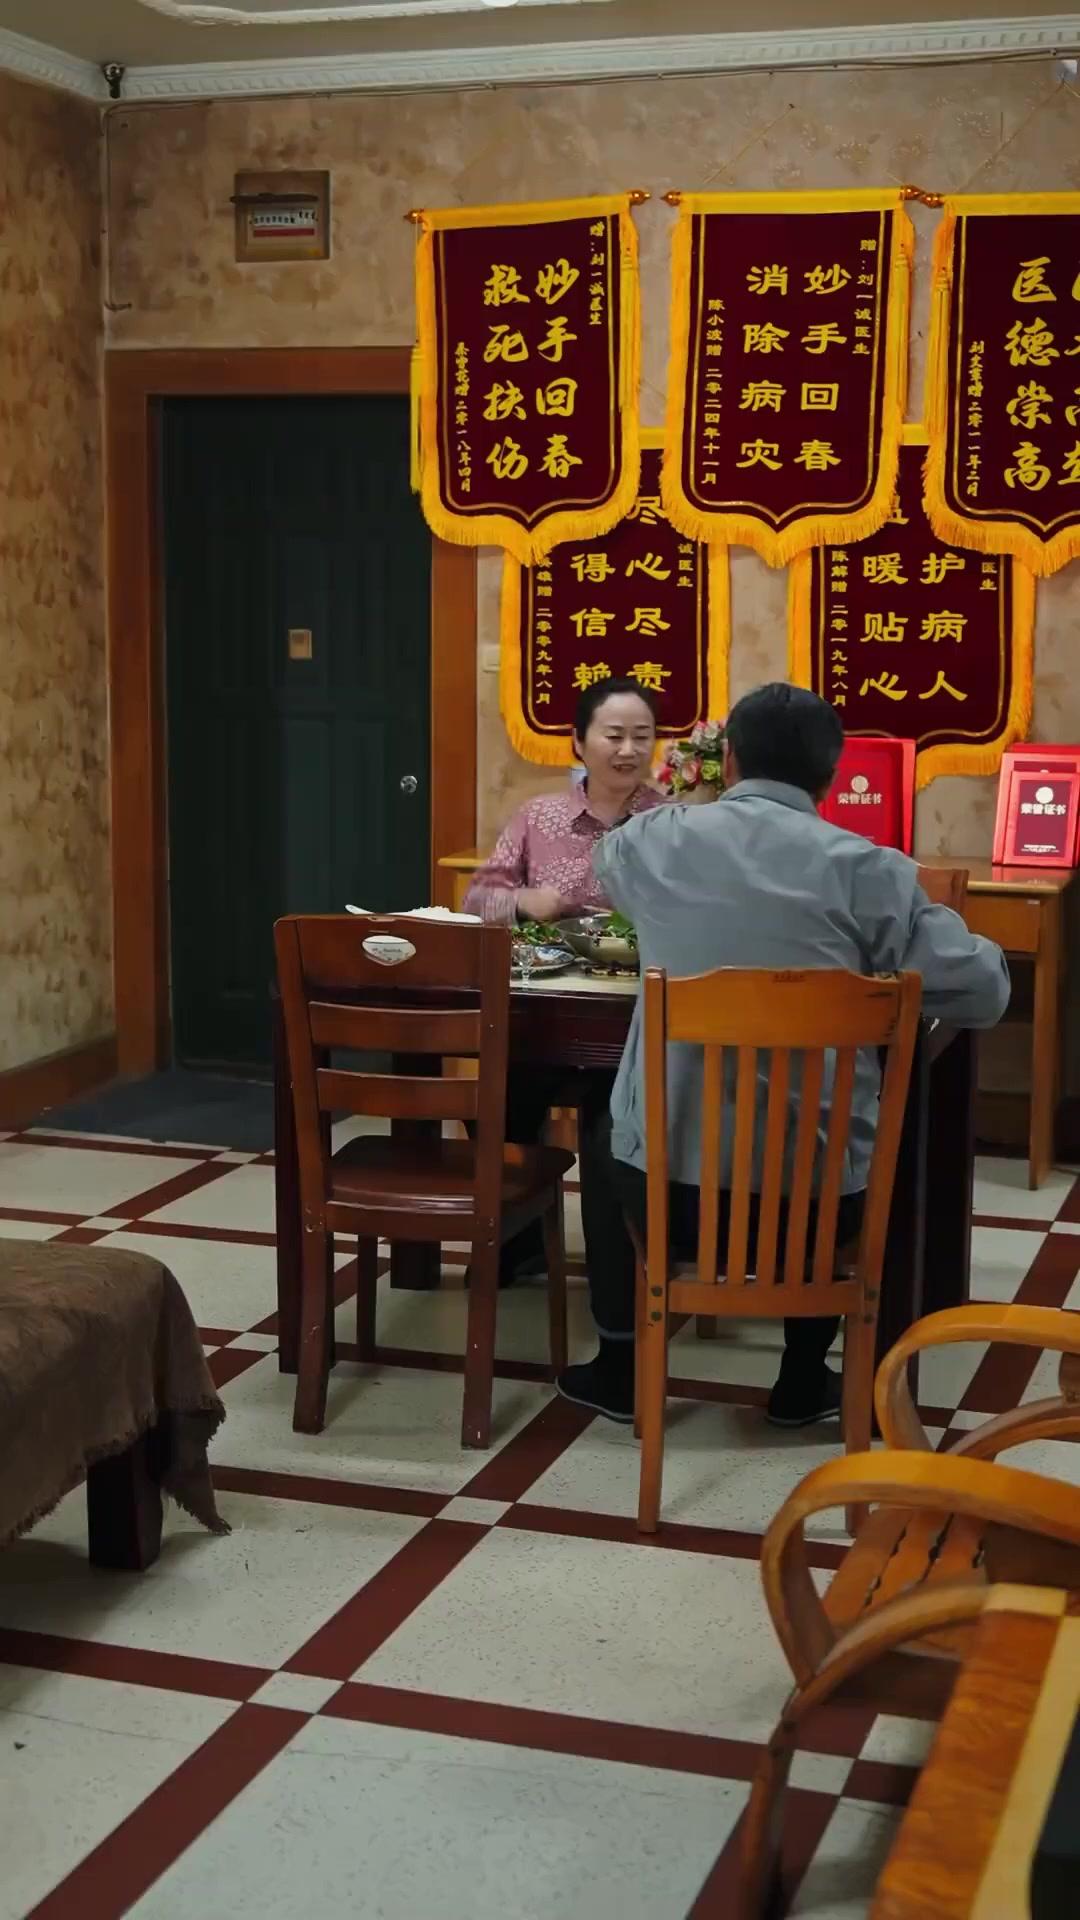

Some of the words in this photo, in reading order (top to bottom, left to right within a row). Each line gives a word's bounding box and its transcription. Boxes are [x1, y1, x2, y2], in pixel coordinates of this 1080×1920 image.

[483, 265, 530, 479] 救死扶伤
[535, 258, 582, 479] 妙手回春
[701, 368, 722, 484] 二零二四年十一月
[736, 263, 790, 470] 消除病灾
[794, 263, 851, 471] 妙手回春
[1004, 256, 1060, 491] 医德崇高
[536, 608, 552, 704] 二零零九年八月
[625, 495, 672, 692] 尽心尽责
[831, 604, 848, 707] 二零一九年八月
[919, 552, 968, 701] 护病人
[838, 793, 882, 805] 荣誉证书
[1021, 803, 1066, 815] 荣誉证书
